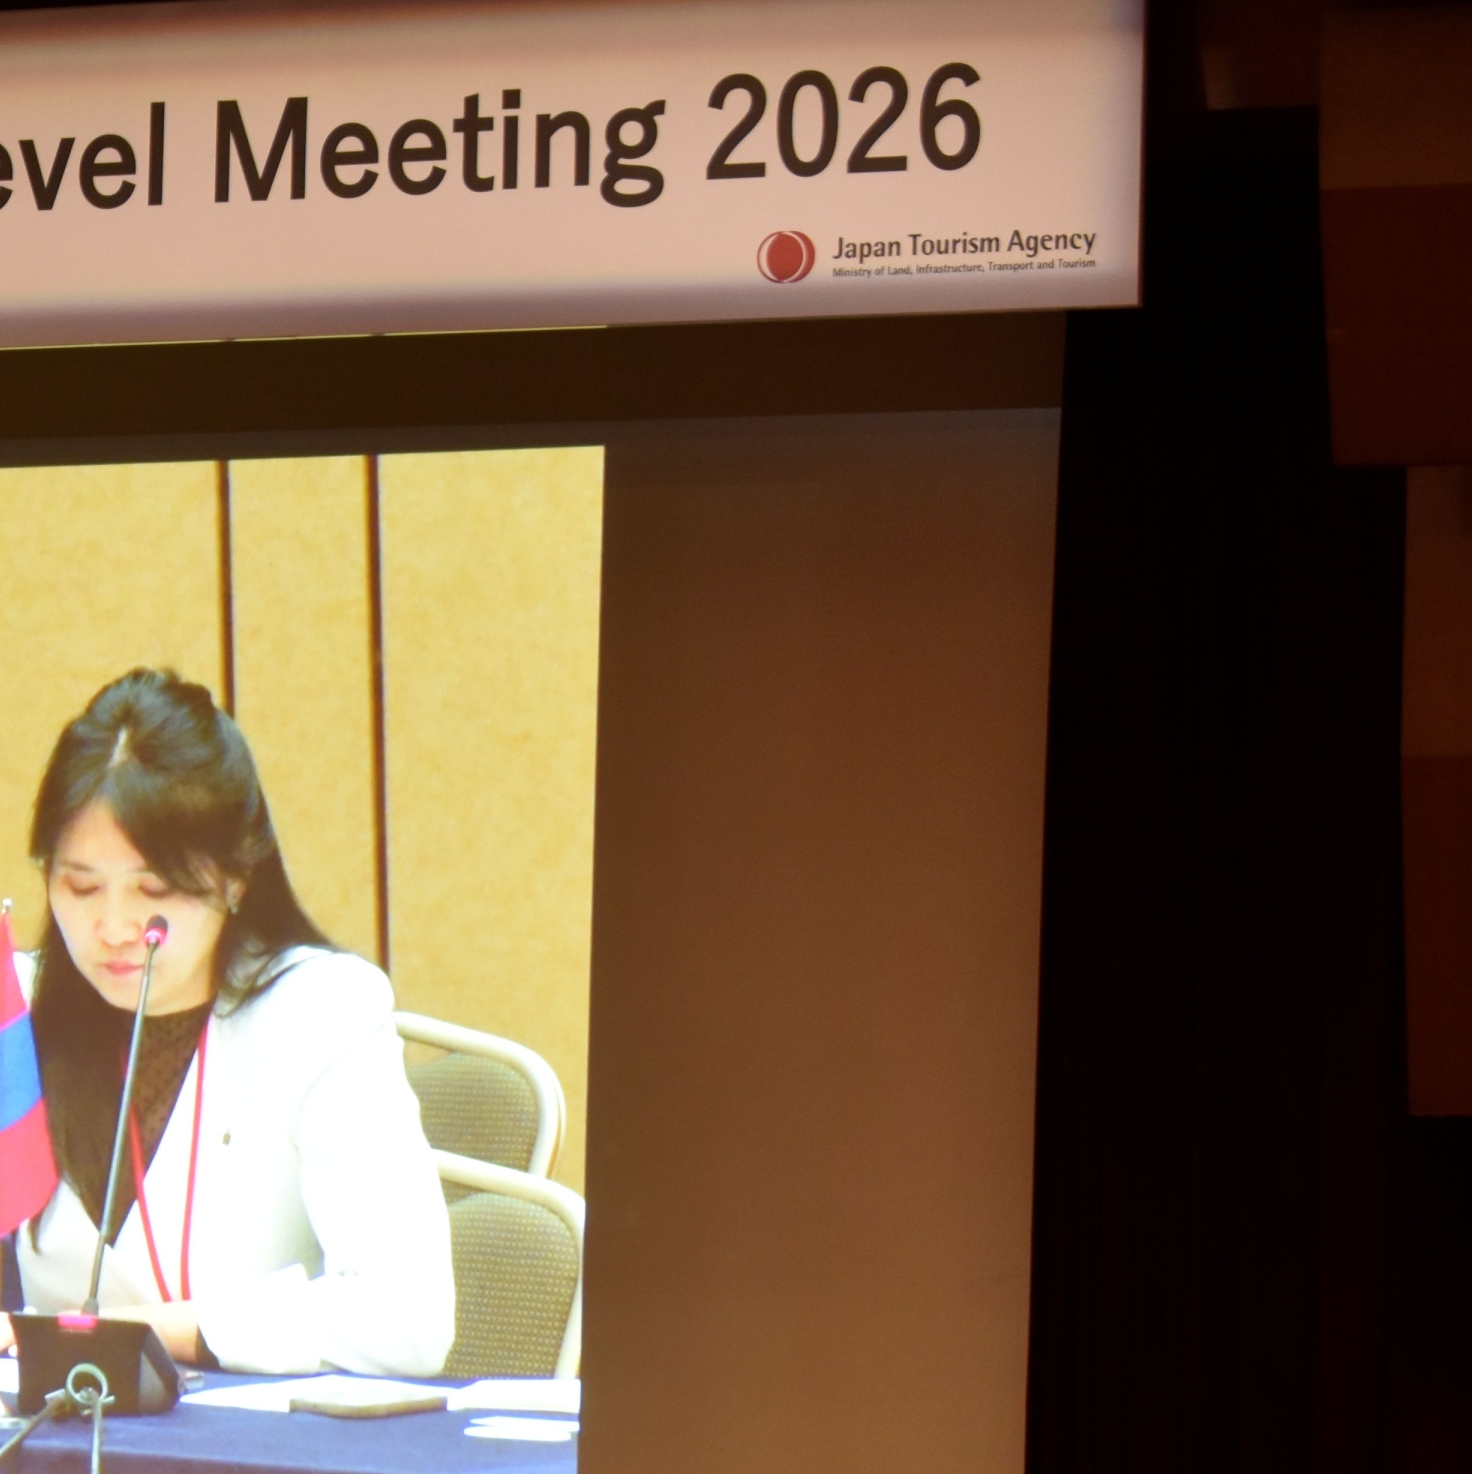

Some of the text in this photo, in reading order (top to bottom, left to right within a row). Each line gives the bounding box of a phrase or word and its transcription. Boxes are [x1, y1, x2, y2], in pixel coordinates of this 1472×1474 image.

[213, 88, 667, 208] Meeting
[705, 62, 982, 181] 2026
[832, 229, 1097, 264] Japan Tourism Agency
[832, 258, 1096, 278] Ministry of Land, Infrastructure, Transport and Tourism
